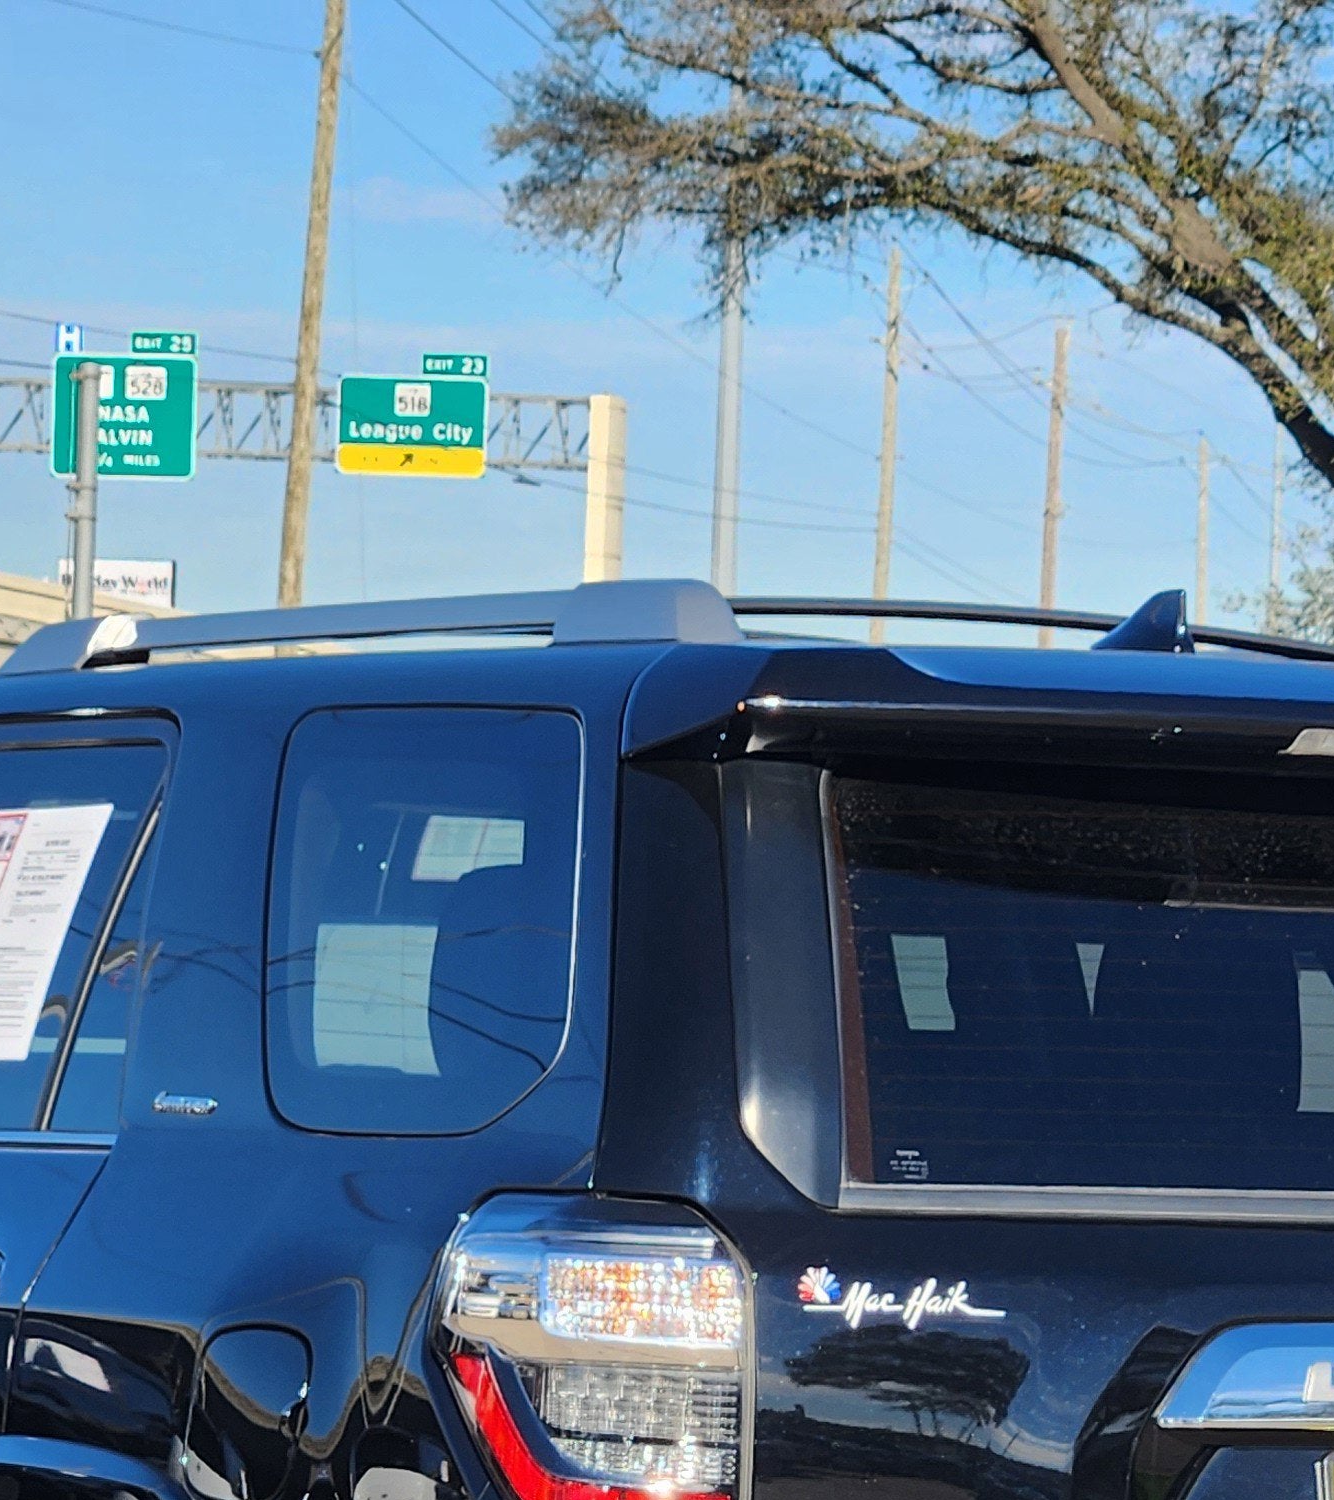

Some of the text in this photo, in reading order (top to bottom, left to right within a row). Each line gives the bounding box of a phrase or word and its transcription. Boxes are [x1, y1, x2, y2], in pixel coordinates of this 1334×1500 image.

[425, 358, 453, 371] EXIT
[98, 405, 150, 423] NASA
[349, 421, 473, 445] League City
[829, 1277, 1006, 1330] Mac Haik
